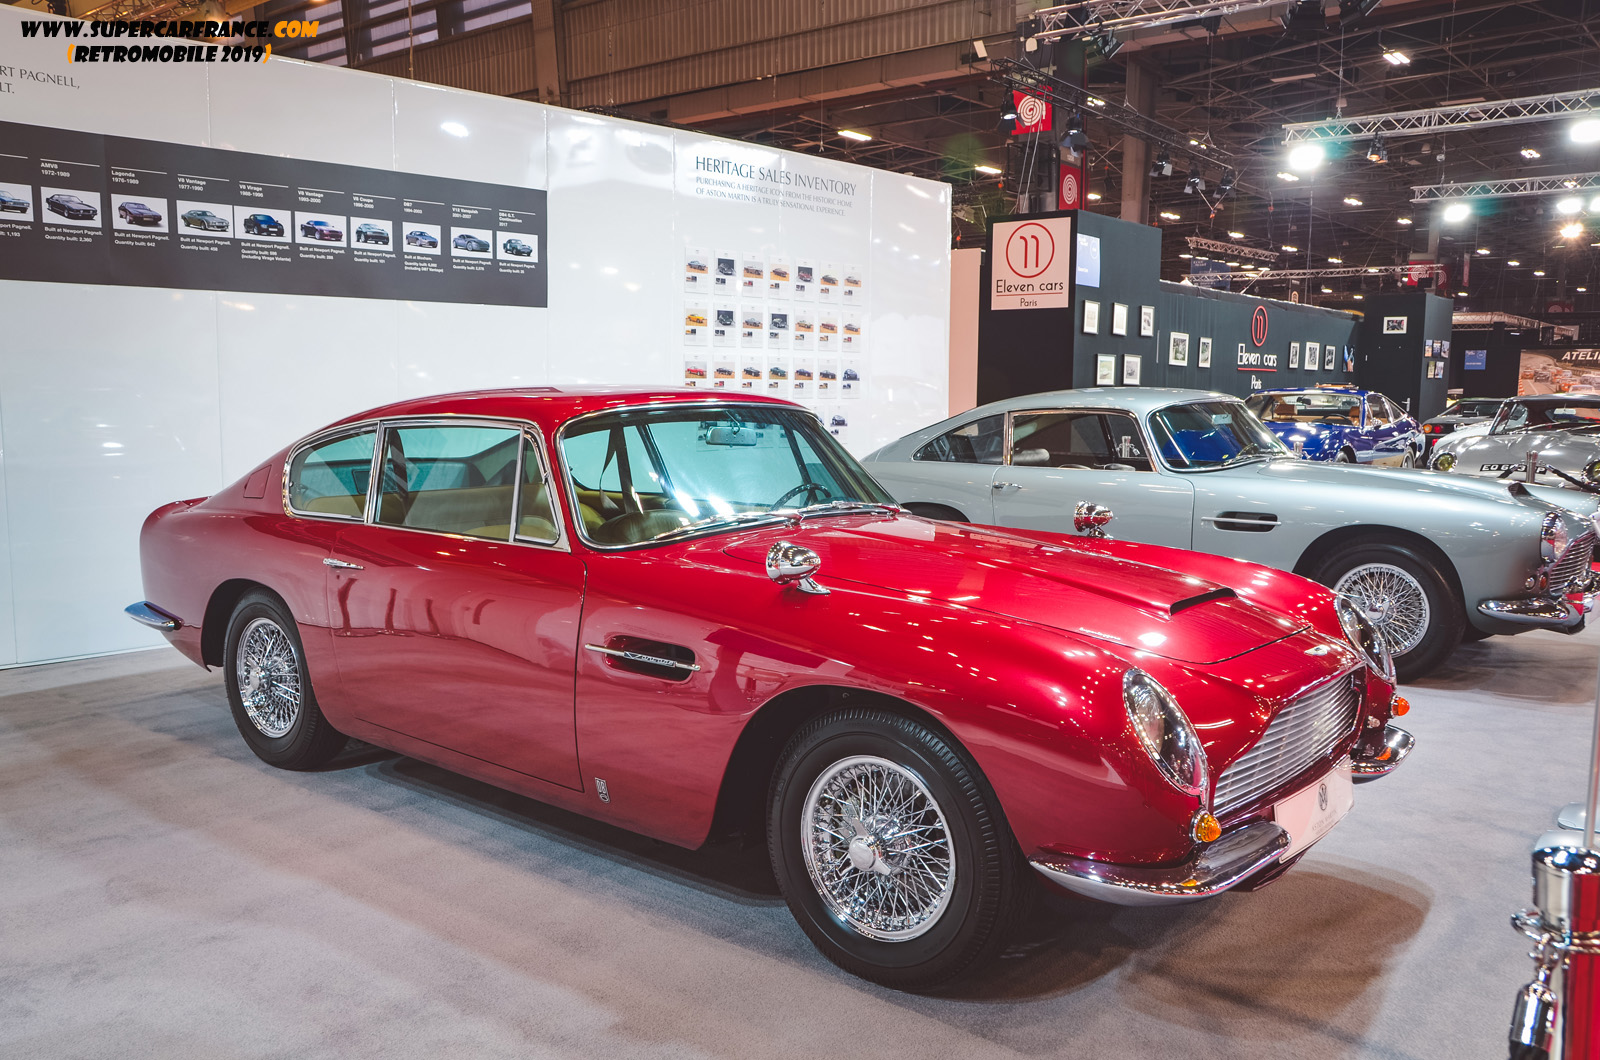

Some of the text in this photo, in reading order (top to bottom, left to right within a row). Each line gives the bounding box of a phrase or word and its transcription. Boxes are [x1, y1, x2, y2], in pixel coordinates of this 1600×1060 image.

[20, 68, 80, 90] PAGNELL,
[696, 156, 857, 196] HERITAGE SALES INVENTORY
[696, 176, 736, 189] PURCHASING
[742, 184, 768, 194] HERITAGE
[770, 188, 784, 197] ICON
[786, 190, 802, 200] FROM
[813, 195, 836, 205] HISTORIC
[837, 200, 852, 208] HOME
[706, 189, 726, 198] ASTON
[728, 192, 750, 202] MARTIN
[762, 198, 779, 206] TRULY
[780, 201, 815, 212] SENSATIONAL
[996, 280, 1064, 293] Eleven cars
[1020, 298, 1037, 307] Paris
[1238, 343, 1277, 367] Eleven cars
[1251, 375, 1262, 389] Paris
